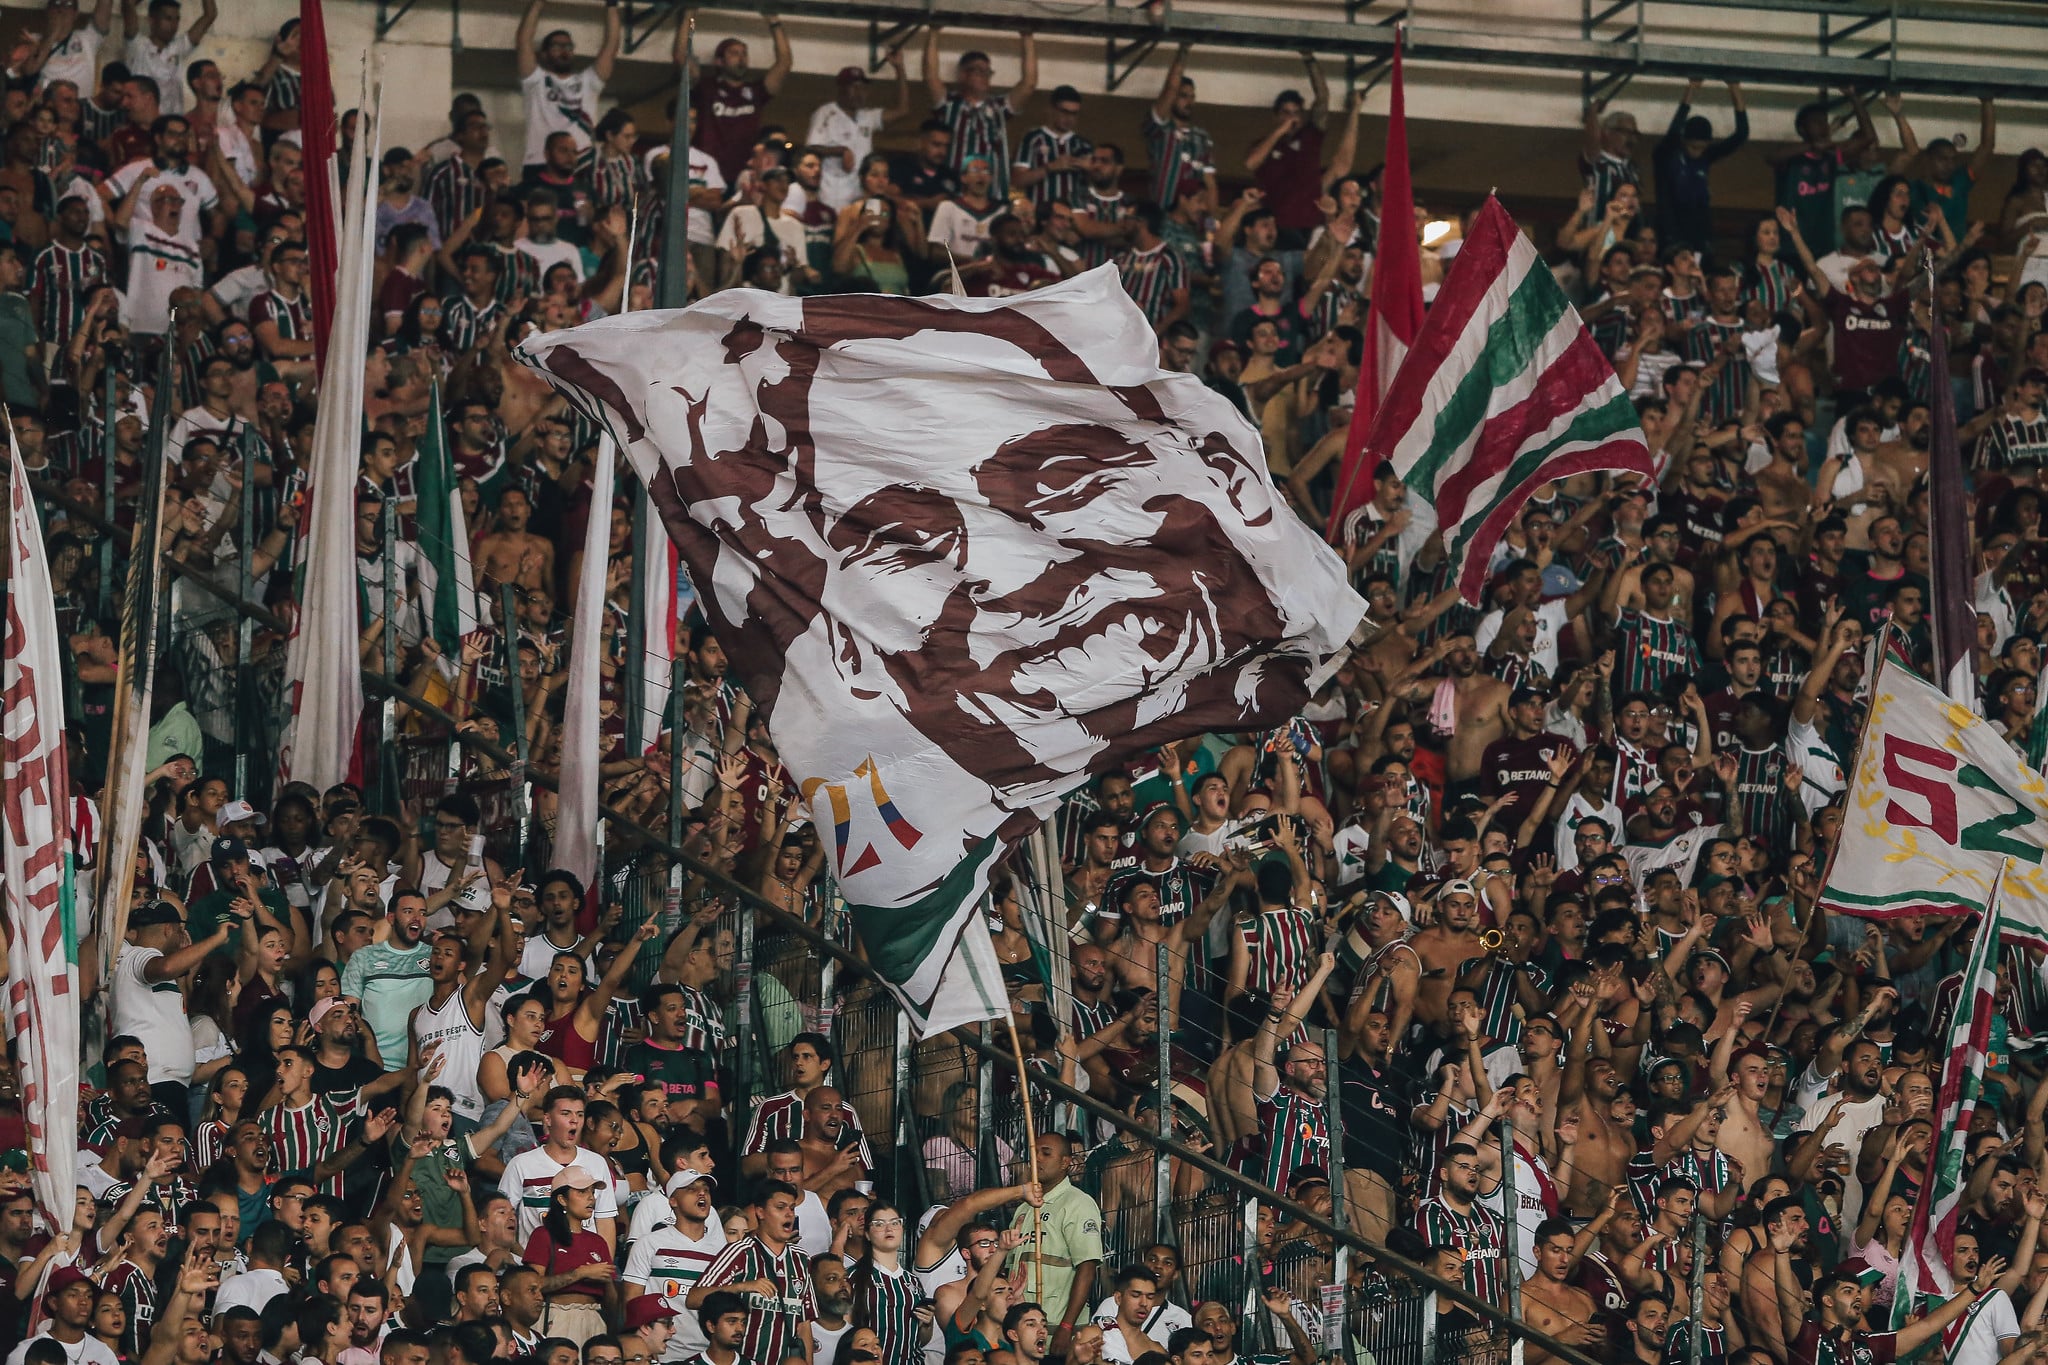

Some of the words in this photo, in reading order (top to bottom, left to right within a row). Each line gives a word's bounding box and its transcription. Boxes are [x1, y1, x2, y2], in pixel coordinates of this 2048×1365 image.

[1651, 649, 1687, 665] BETANO
[482, 666, 505, 686] Uni
[1510, 770, 1552, 782] BETANO
[1738, 783, 1777, 795] BETANO
[1110, 856, 1136, 870] TANO
[1158, 901, 1184, 916] TANO
[1313, 1136, 1331, 1148] ETA
[1466, 1248, 1500, 1261] BETANO
